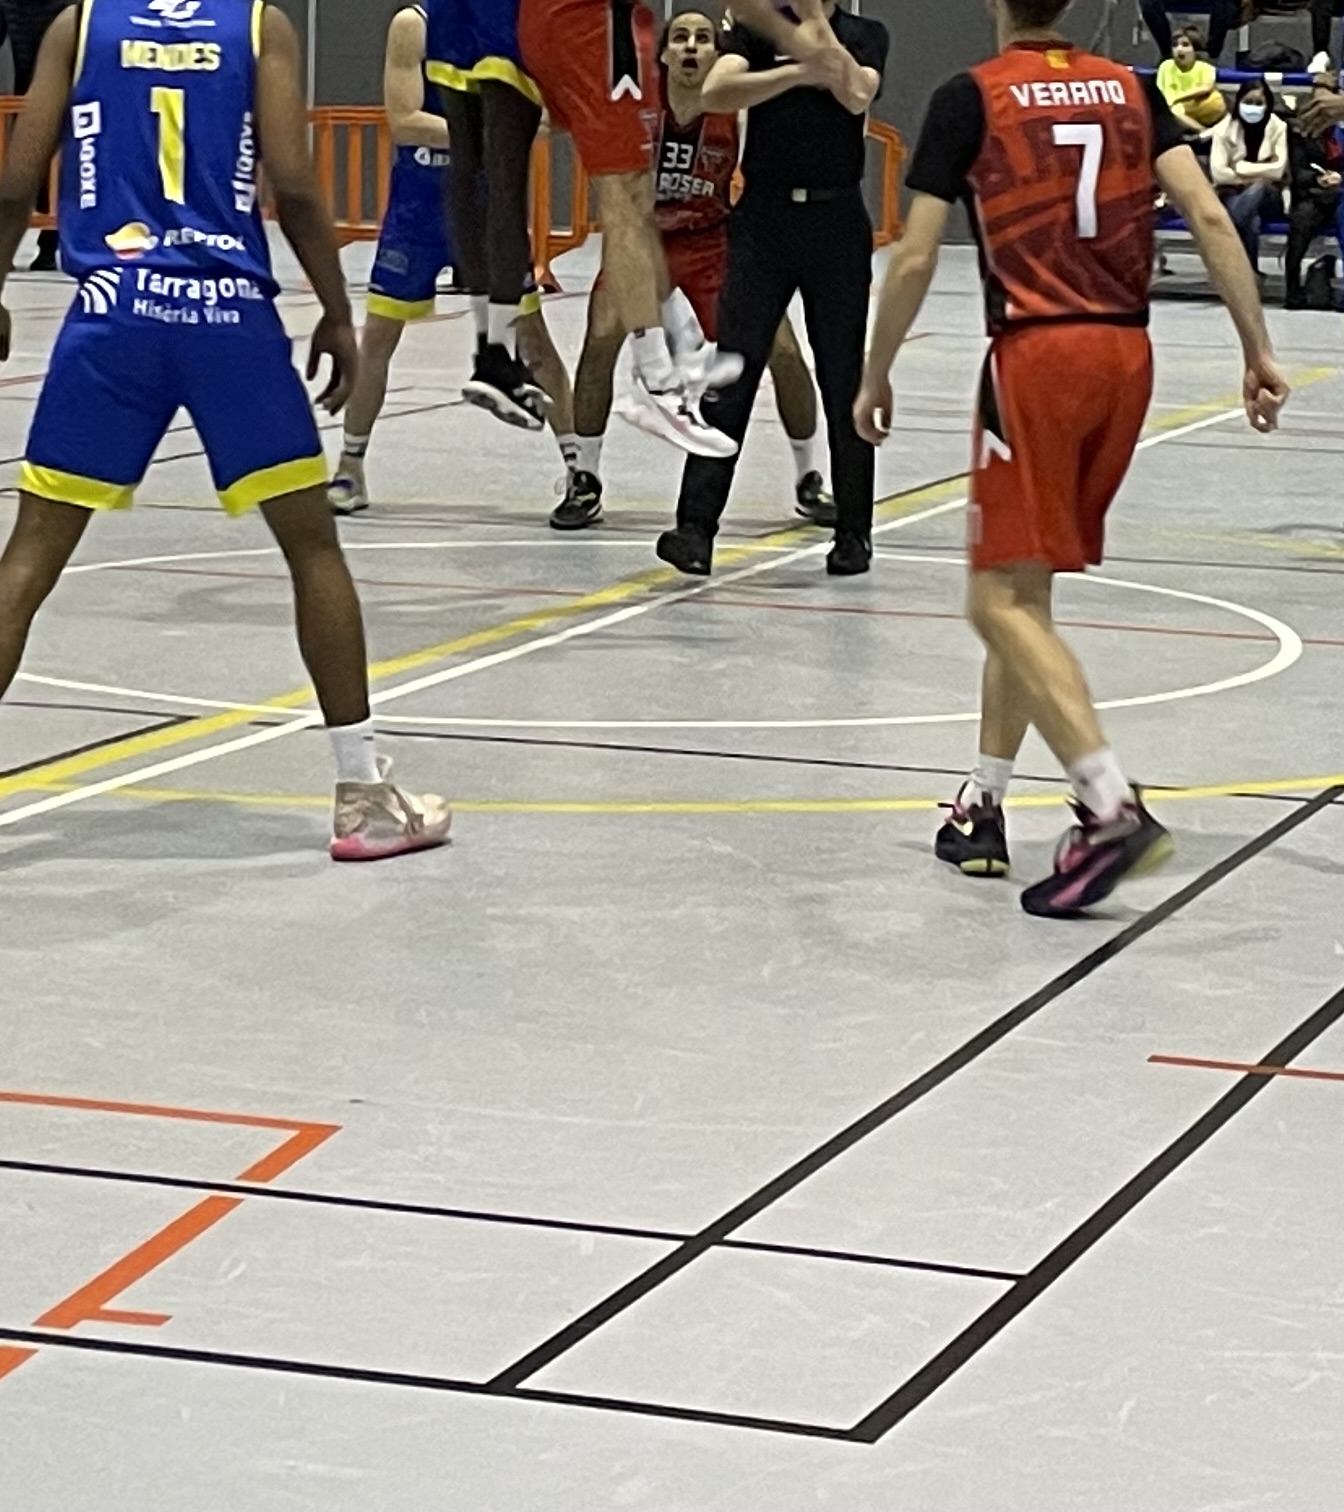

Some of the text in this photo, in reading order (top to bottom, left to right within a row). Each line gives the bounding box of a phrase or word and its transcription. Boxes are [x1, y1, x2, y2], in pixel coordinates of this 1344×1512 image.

[120, 39, 222, 71] MENDES
[1009, 80, 1126, 108] VERANO
[150, 88, 186, 206] 1
[662, 141, 694, 169] 33
[1051, 123, 1104, 238] 7
